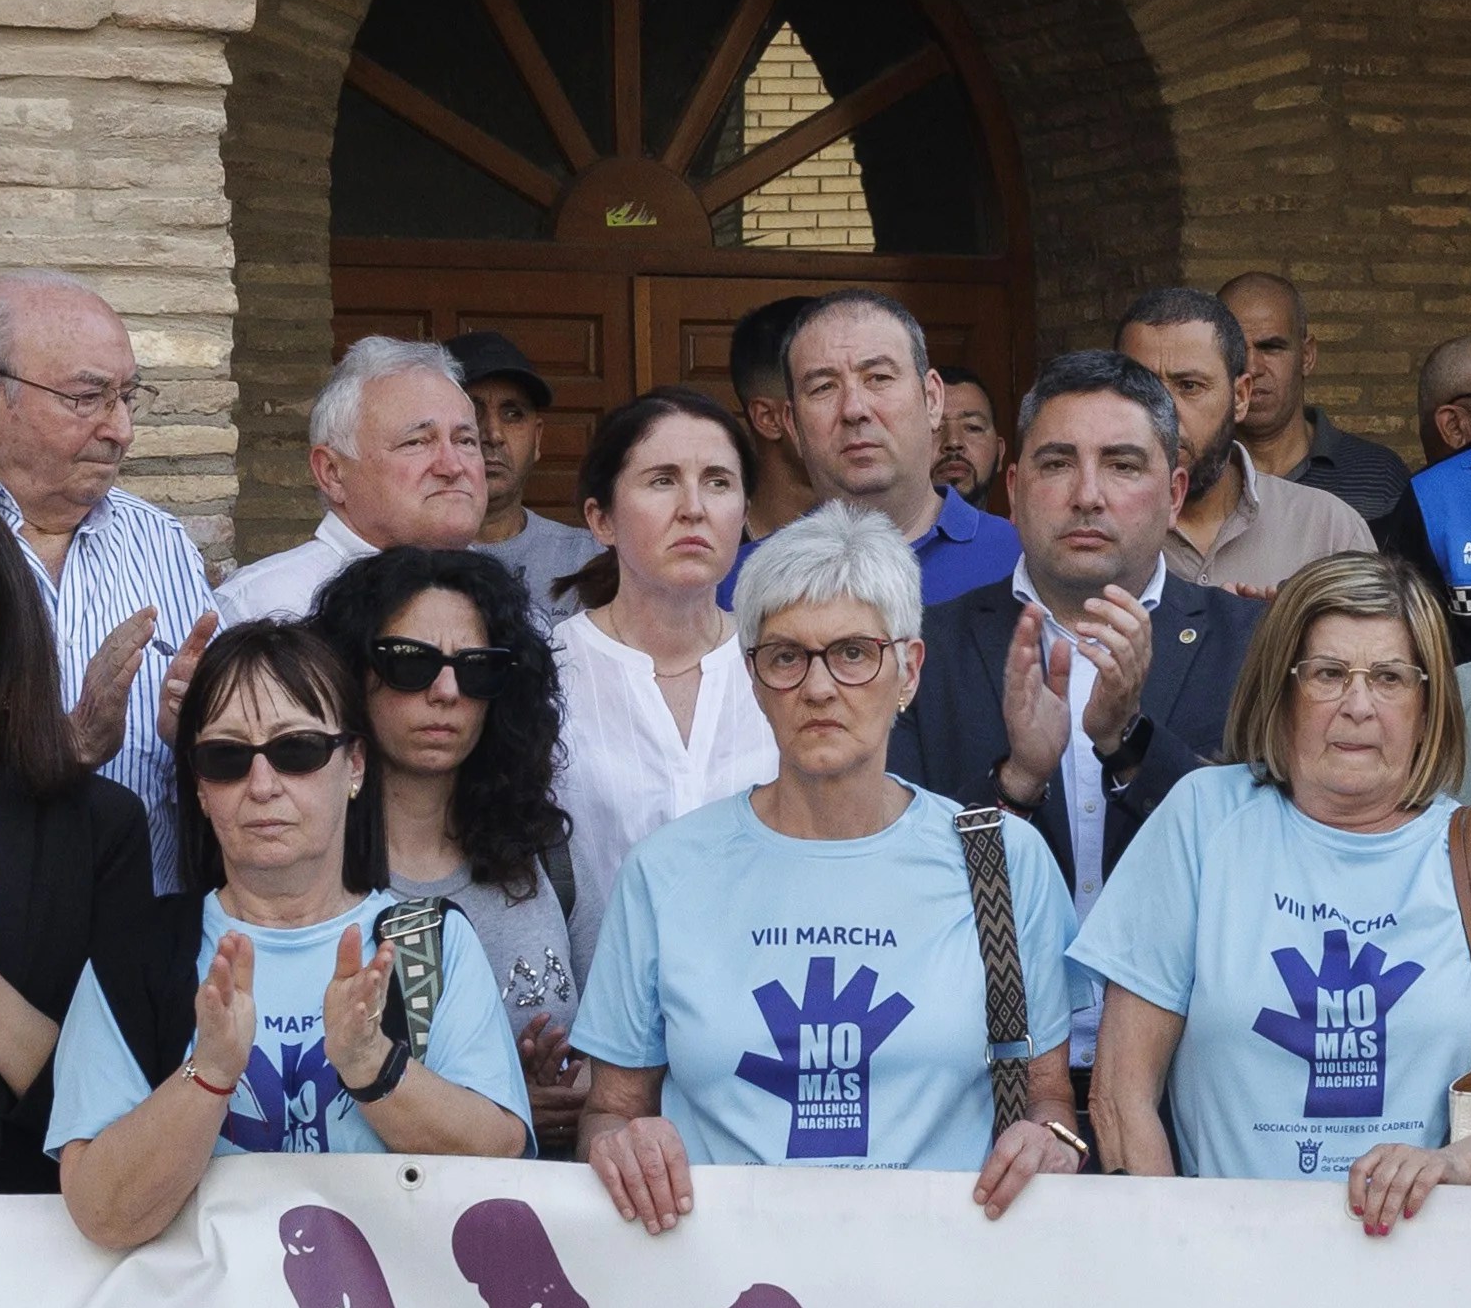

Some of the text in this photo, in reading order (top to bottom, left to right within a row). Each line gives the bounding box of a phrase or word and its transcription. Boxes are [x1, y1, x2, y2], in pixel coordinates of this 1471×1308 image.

[1274, 893, 1306, 921] VIII
[751, 926, 898, 948] VIII MARCHA
[1316, 983, 1378, 1029] NO
[264, 1015, 323, 1034] MAR
[799, 1022, 862, 1070] NO
[1314, 1027, 1378, 1060] MÁS
[1314, 1060, 1378, 1074] VIOLENCIA
[798, 1068, 862, 1102] MÁS
[1314, 1074, 1378, 1088] MACHISTA
[797, 1102, 862, 1116] VIOLENCIA
[797, 1116, 862, 1130] MACHISTA
[1253, 1120, 1425, 1134] ASOCIACIÓN DE MUJERES DE CADREITA
[1321, 1155, 1357, 1165] Ayuntam
[1320, 1164, 1349, 1173] de Cad
